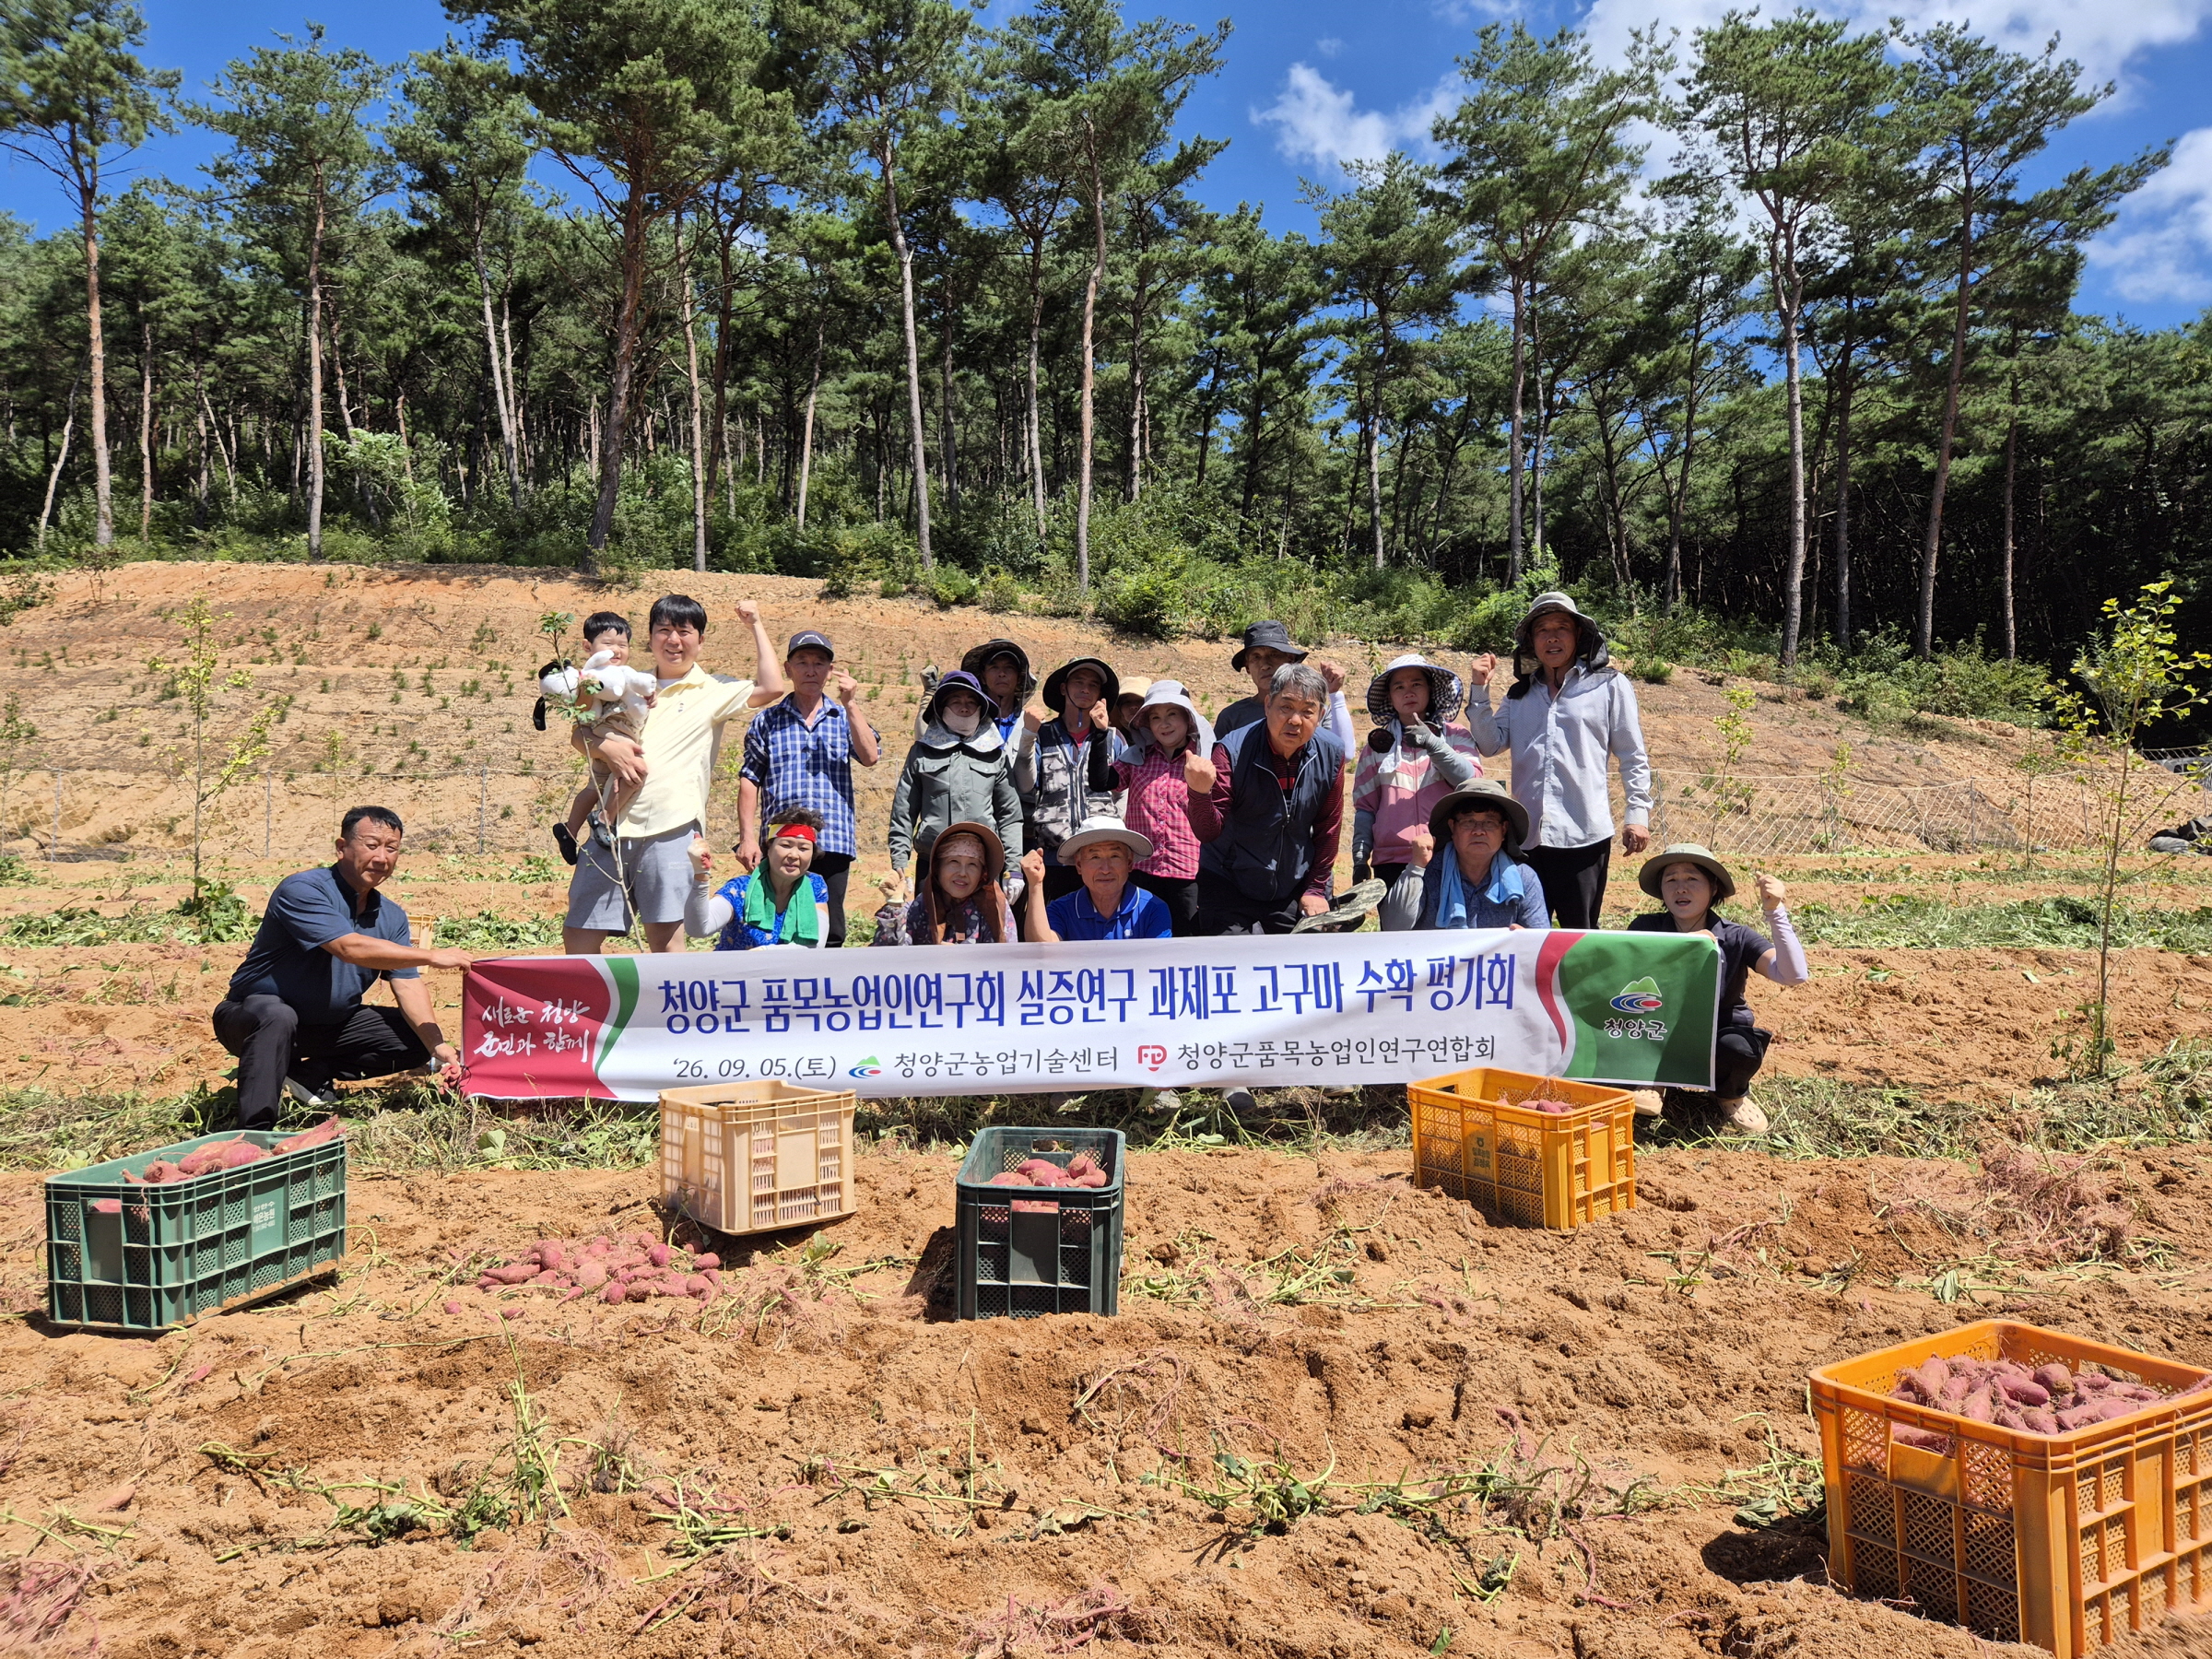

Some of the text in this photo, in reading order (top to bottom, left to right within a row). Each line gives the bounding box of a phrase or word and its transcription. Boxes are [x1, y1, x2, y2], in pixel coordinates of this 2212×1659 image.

[657, 953, 1516, 1034] 청양군 품목농업인연구회 실증연구 과제포 고구마 수확 평가회
[481, 995, 591, 1029] 새로운 청양
[1604, 1017, 1668, 1041] 청양군
[473, 1026, 590, 1064] 군민과 함께
[893, 1045, 1119, 1078] 청양군농업기술센터
[1177, 1034, 1496, 1071] 청양군품목농업인연구연합회
[718, 1058, 750, 1078] 09.
